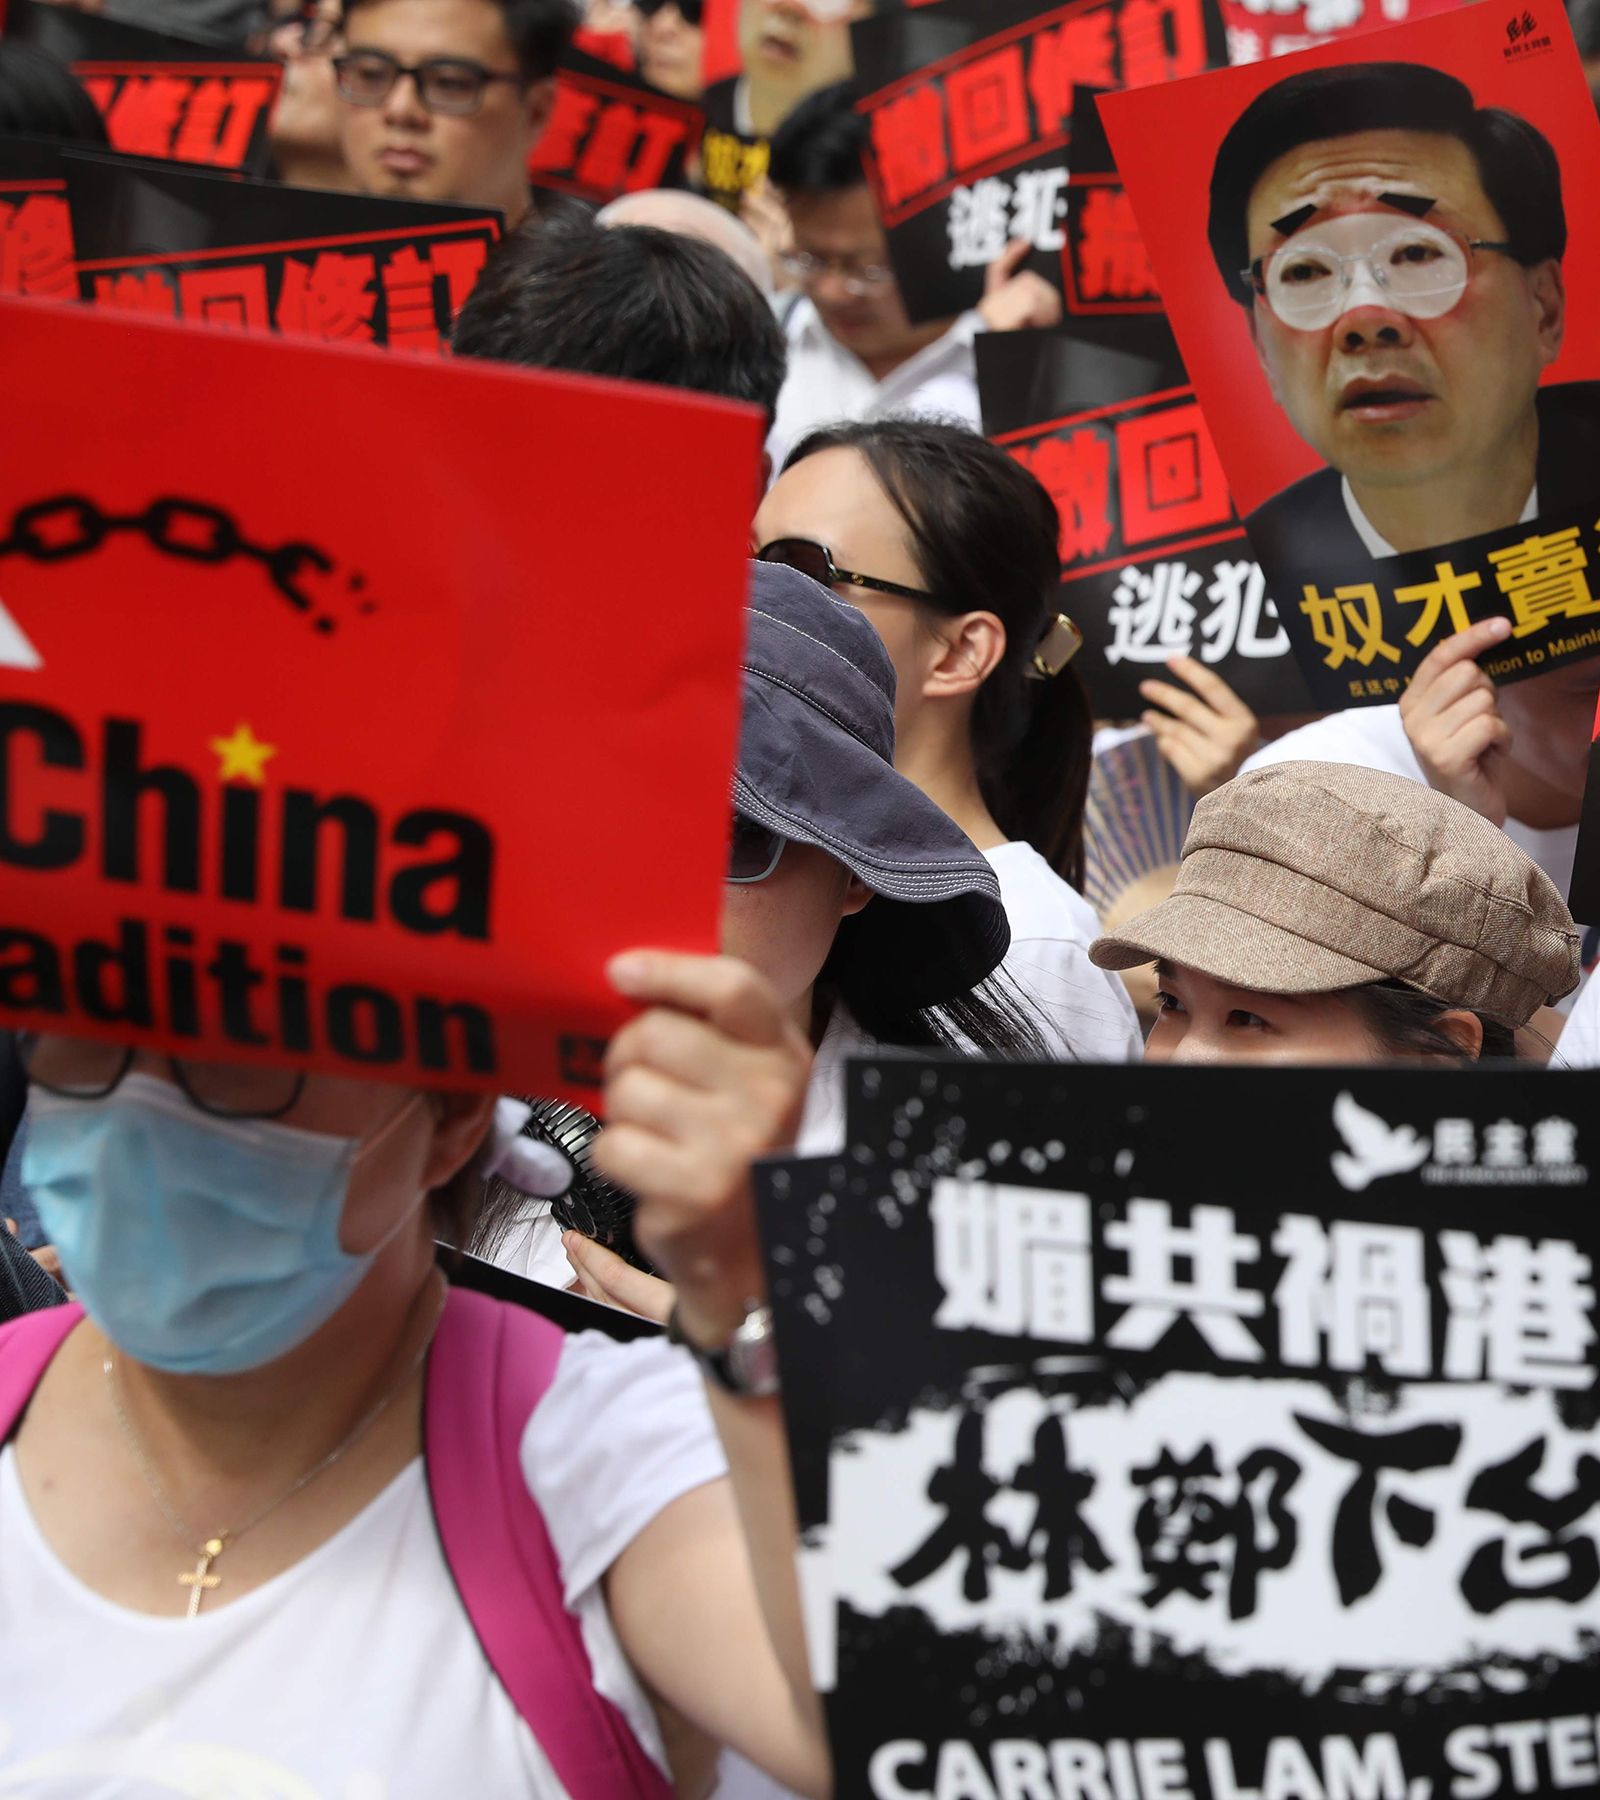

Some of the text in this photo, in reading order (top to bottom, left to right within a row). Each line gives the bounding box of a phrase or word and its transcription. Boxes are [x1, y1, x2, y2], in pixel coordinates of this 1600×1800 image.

[1104, 560, 1292, 665] 逃犯
[1526, 648, 1544, 664] to
[0, 699, 496, 942] China
[931, 1177, 1600, 1391] 媚共禍港
[868, 1739, 1194, 1800] CARRIE
[1209, 1732, 1432, 1800] LAM,
